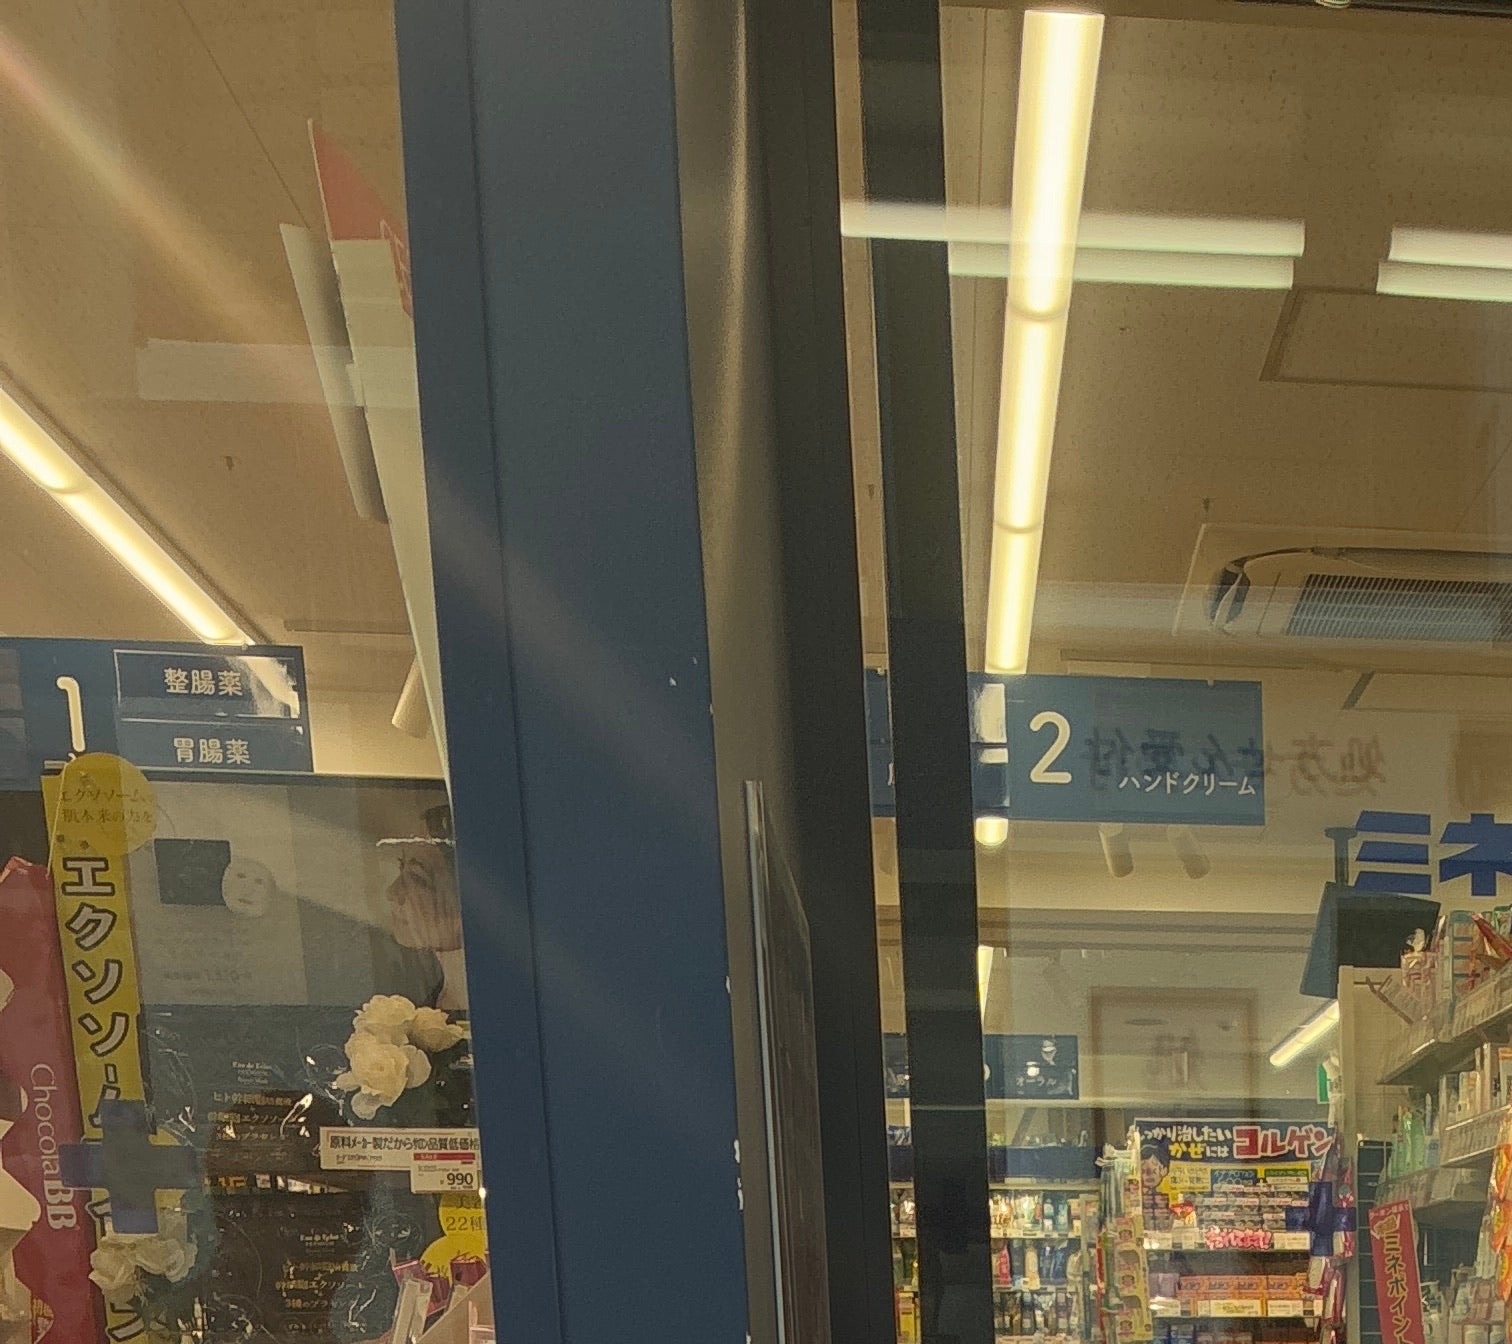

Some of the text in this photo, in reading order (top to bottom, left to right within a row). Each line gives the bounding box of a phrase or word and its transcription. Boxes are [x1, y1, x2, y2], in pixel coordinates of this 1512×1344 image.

[164, 667, 243, 697] 整腸薬
[173, 738, 251, 765] 胃腸薬
[1029, 712, 1073, 784] 2
[1118, 773, 1257, 797] ハンドクリーム
